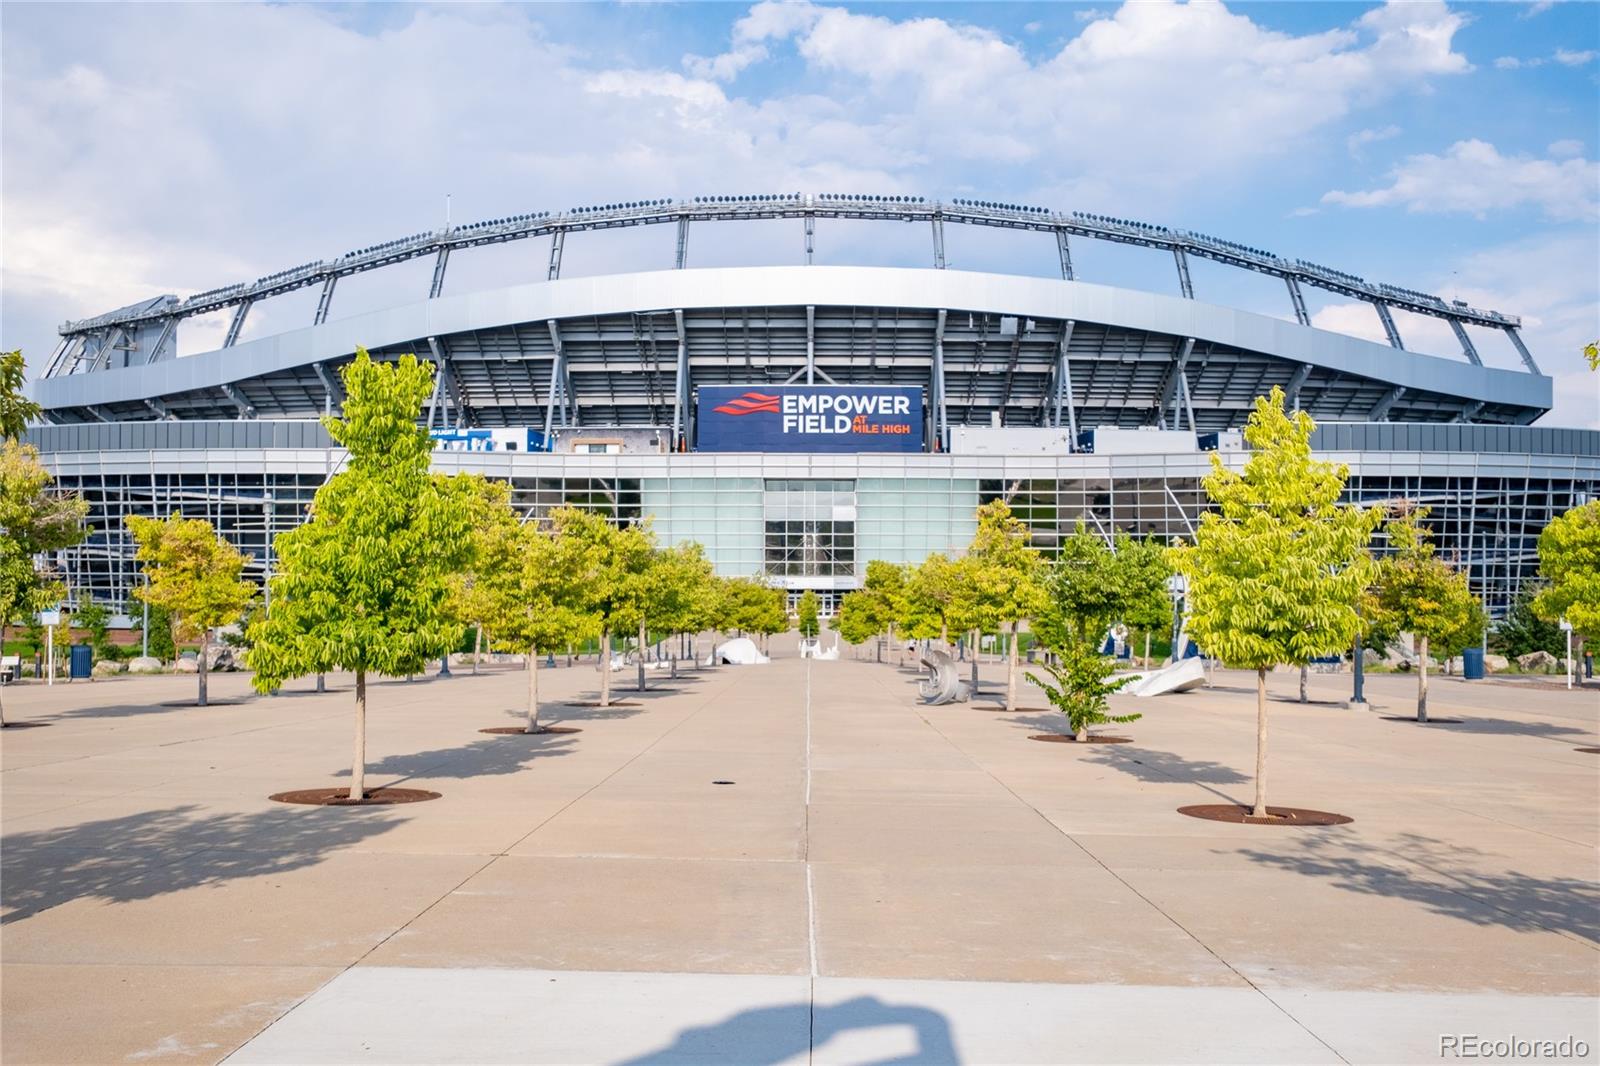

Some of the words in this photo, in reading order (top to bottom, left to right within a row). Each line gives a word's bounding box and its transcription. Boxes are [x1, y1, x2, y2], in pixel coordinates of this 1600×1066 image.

[783, 395, 910, 414] EMPOWER
[783, 415, 852, 434] FIELD
[853, 415, 868, 424] AT
[853, 424, 879, 434] MILE
[882, 425, 910, 434] HIGH
